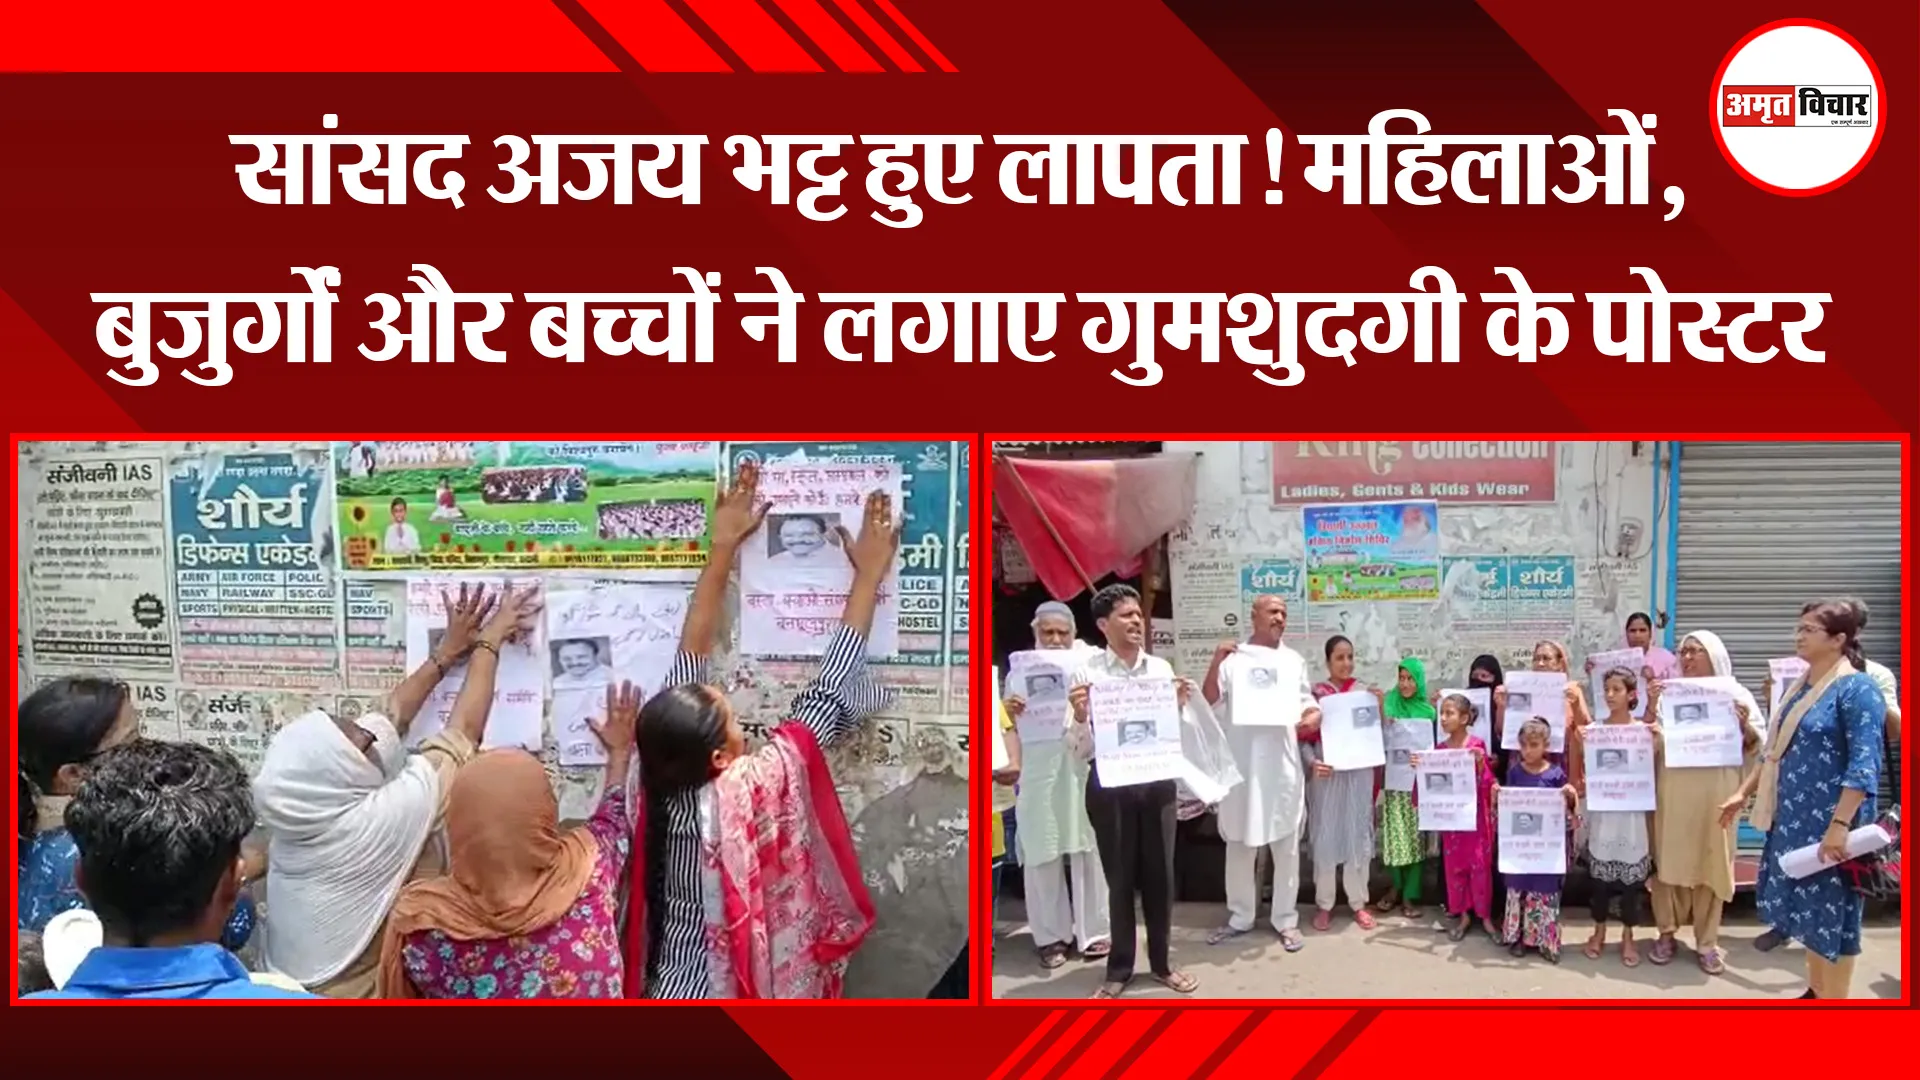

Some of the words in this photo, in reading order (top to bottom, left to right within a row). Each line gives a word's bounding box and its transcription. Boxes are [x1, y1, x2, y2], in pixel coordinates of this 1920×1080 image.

[47, 463, 117, 484] संजीवनी
[123, 464, 152, 481] IAS
[1281, 485, 1346, 499] Ladies,
[1352, 483, 1404, 497] Gents
[1410, 483, 1424, 496] &
[1430, 482, 1470, 496] Kids
[1476, 482, 1529, 495] Wear
[197, 483, 308, 529] शौर्य
[176, 534, 249, 566] डिफेन्स
[254, 534, 319, 566] एकेड
[181, 573, 211, 583] ARMY
[221, 573, 238, 582] AIR
[241, 573, 276, 582] FORCE
[288, 573, 323, 582] POLIC
[1252, 569, 1297, 588] शौर्य
[1520, 566, 1564, 584] शौर्य
[902, 579, 936, 590] LICE
[181, 588, 208, 598] NAVY
[222, 588, 275, 598] RAILWAY
[350, 588, 373, 598] NAV
[182, 603, 217, 614] SPORTS
[901, 598, 940, 609] C-GD
[351, 604, 389, 615] SPORTS
[136, 685, 167, 702] IAS
